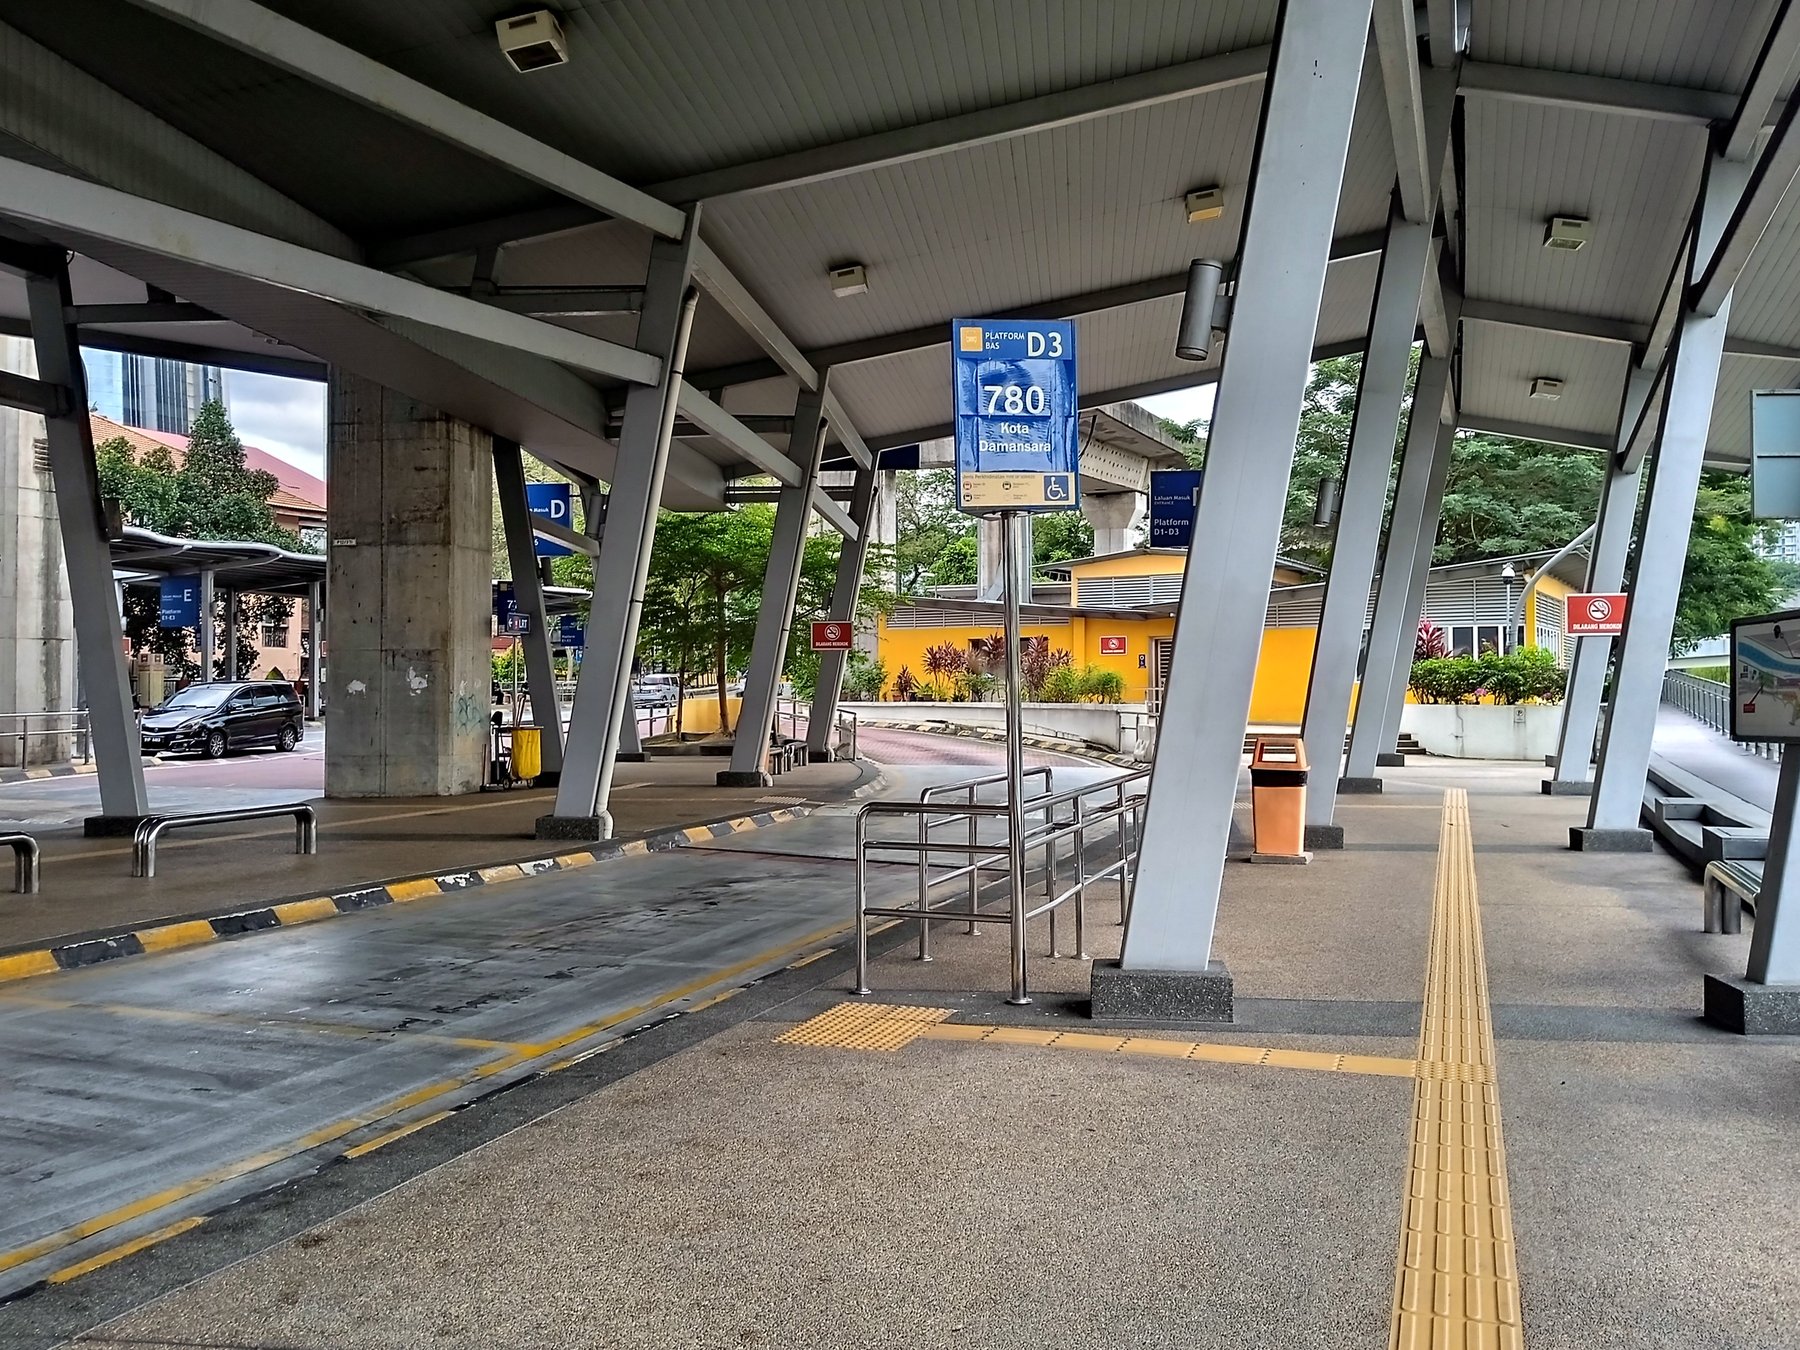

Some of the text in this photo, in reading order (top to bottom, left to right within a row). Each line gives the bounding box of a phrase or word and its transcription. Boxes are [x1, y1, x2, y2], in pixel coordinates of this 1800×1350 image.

[985, 332, 1025, 340] PLATFORM
[985, 341, 1000, 350] BAS
[984, 385, 1044, 414] 780
[1000, 422, 1029, 434] Kota
[980, 440, 1051, 452] Damansara
[550, 499, 566, 519] D
[1154, 518, 1189, 526] Platform
[1154, 528, 1180, 536] D1-D3
[184, 589, 192, 601] E
